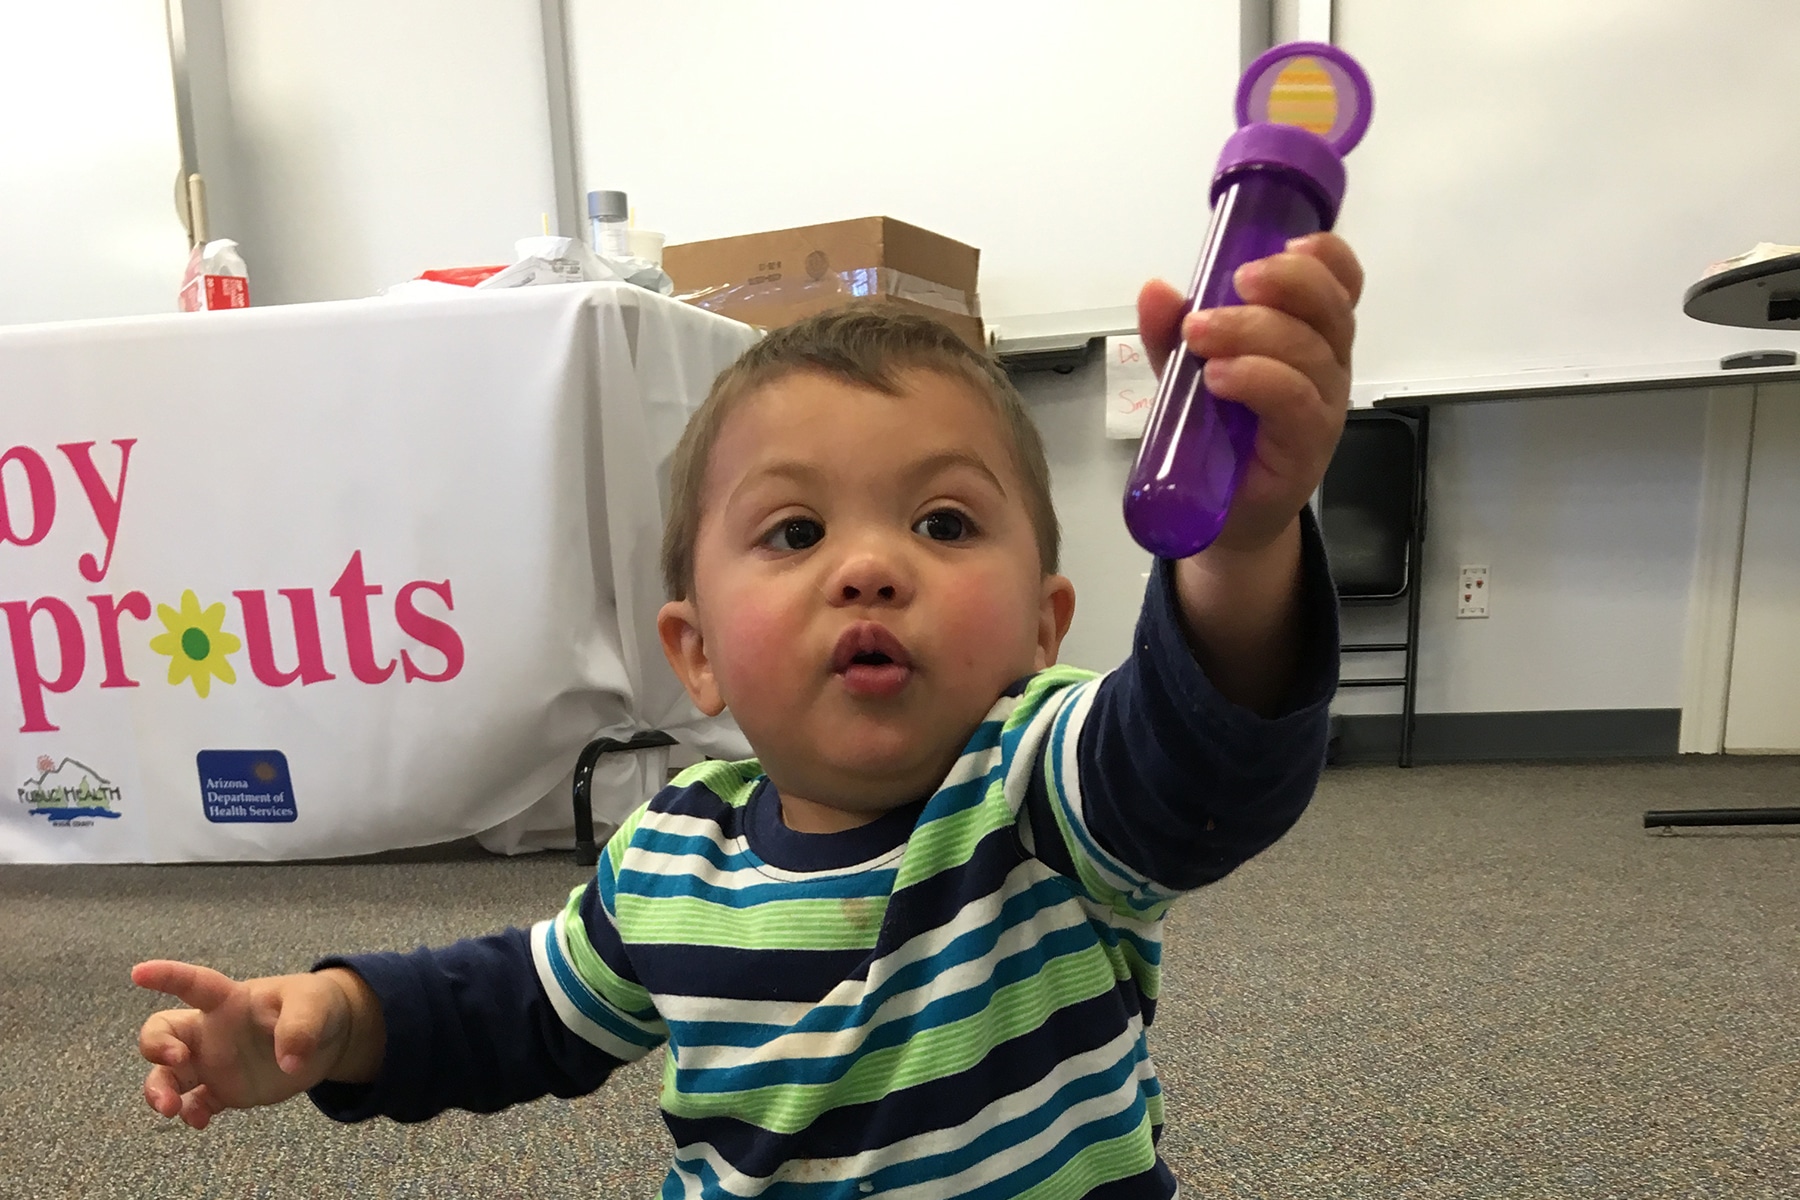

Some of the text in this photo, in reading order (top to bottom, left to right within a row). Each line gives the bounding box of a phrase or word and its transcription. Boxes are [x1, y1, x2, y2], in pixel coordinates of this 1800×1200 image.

[206, 778, 249, 789] Arizona
[63, 786, 122, 802] HEALTH
[207, 791, 285, 806] Department of
[209, 805, 294, 817] Health Services
